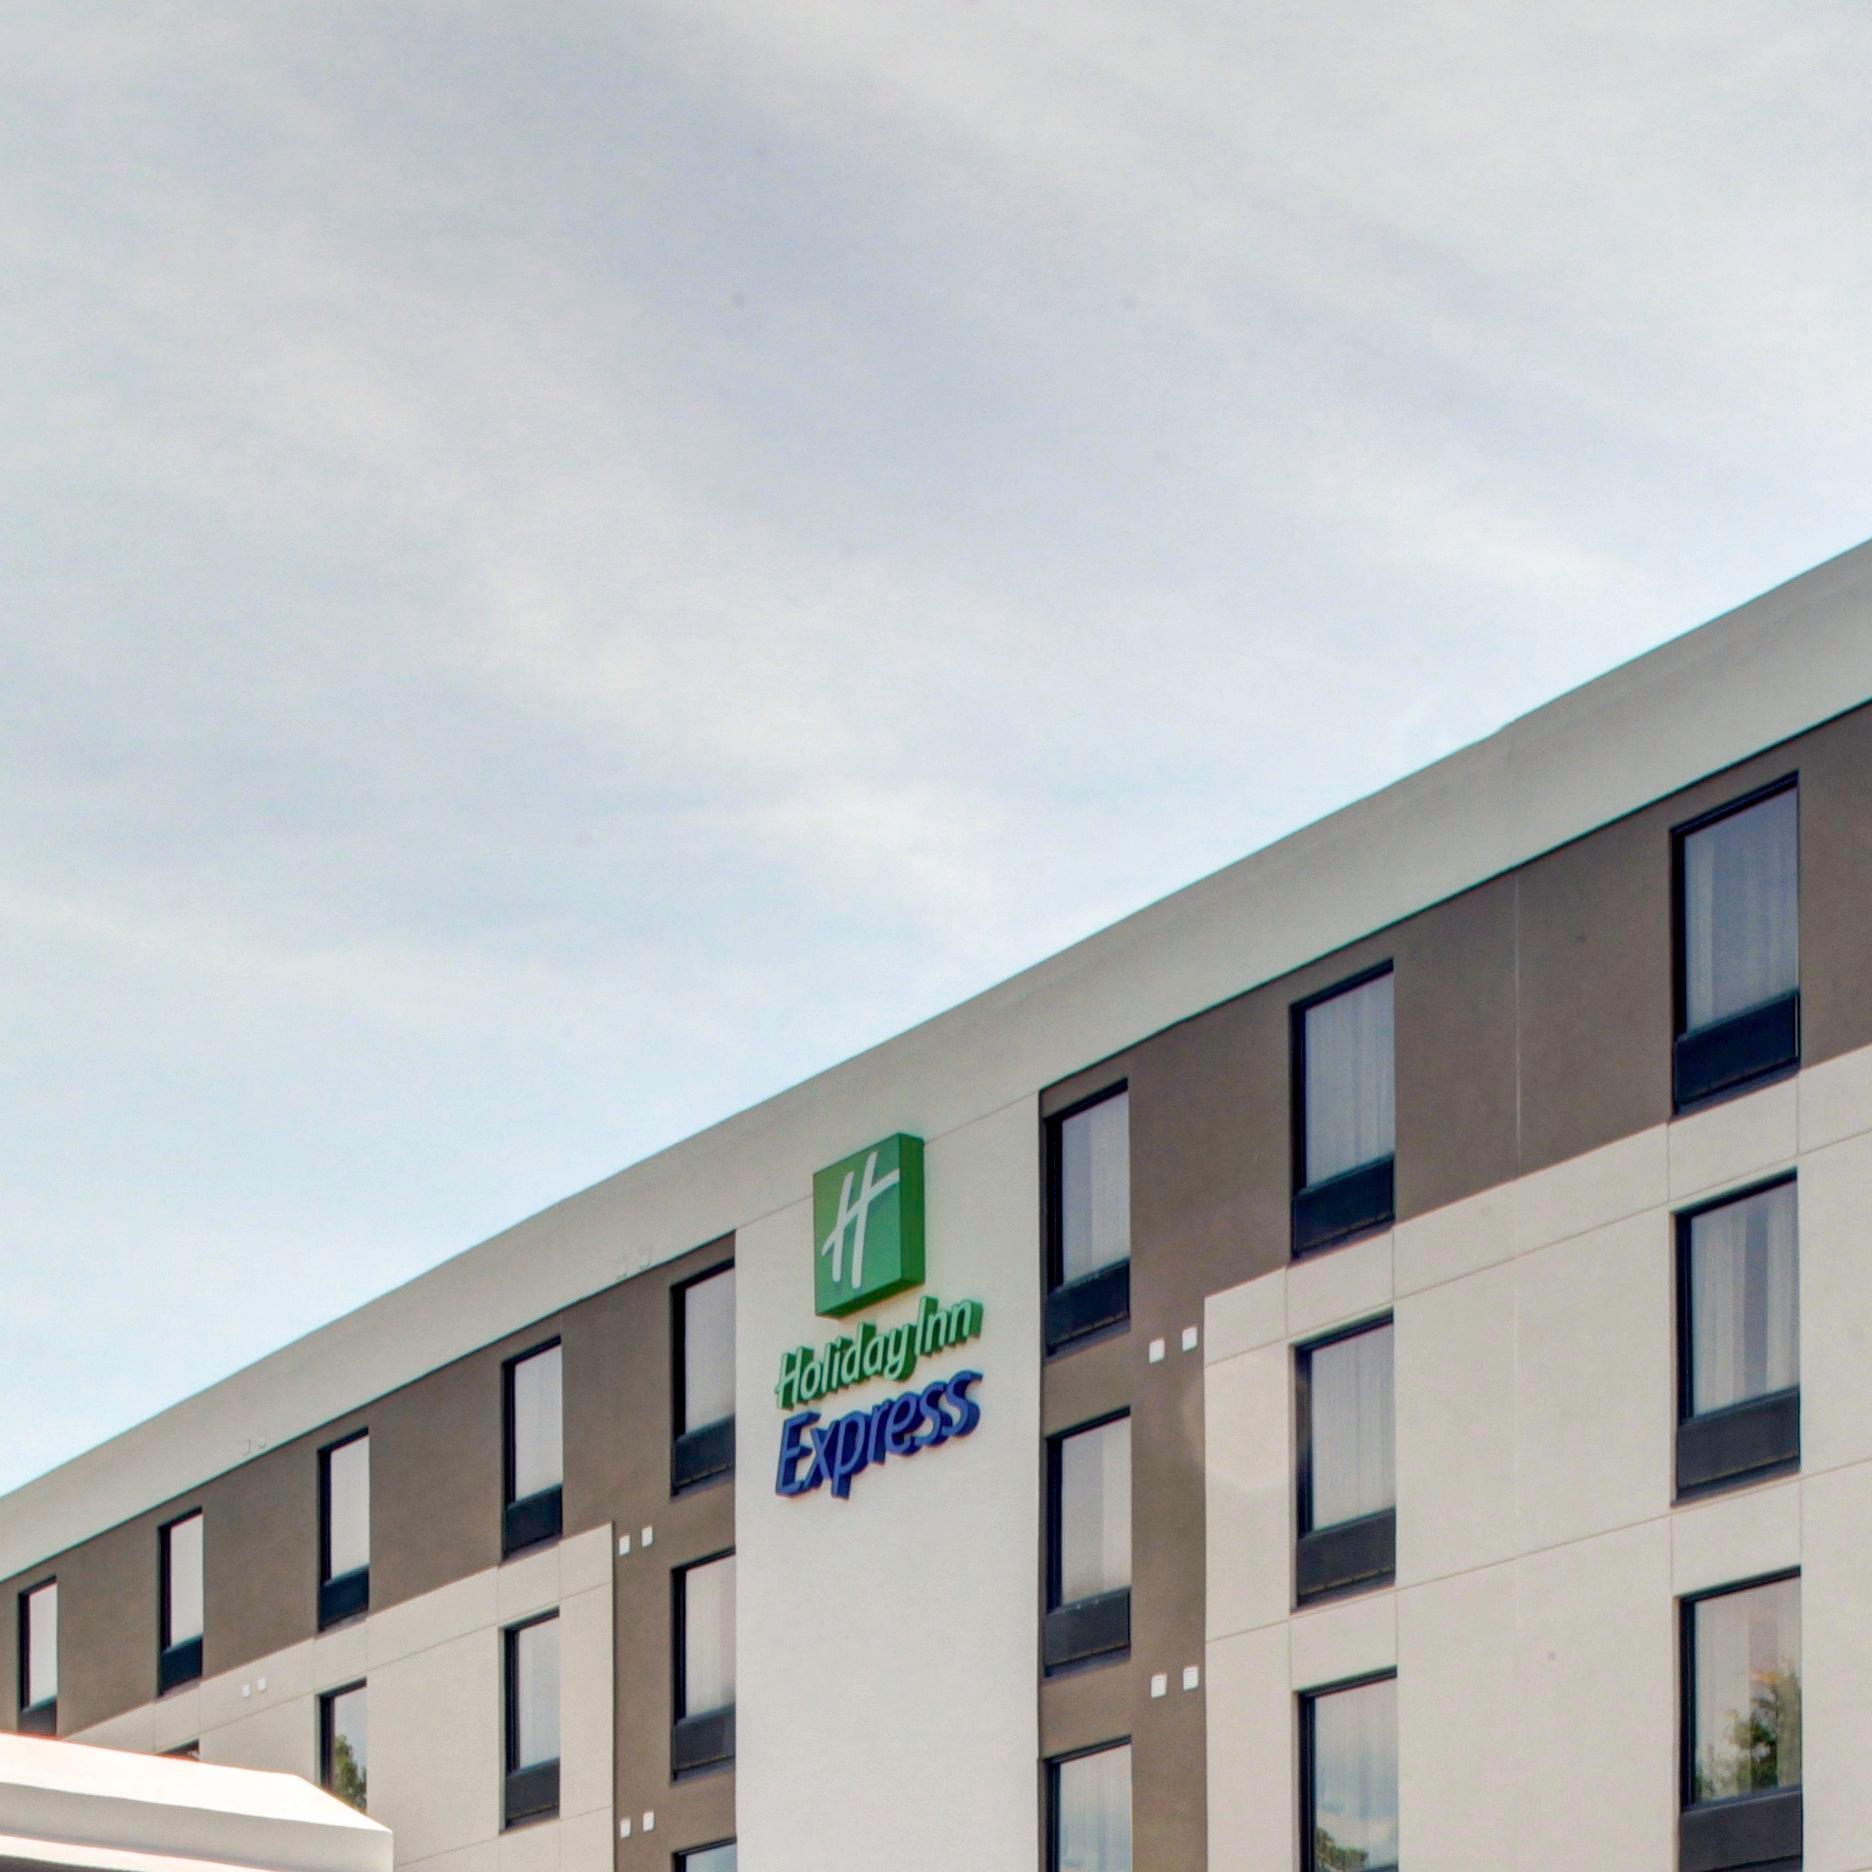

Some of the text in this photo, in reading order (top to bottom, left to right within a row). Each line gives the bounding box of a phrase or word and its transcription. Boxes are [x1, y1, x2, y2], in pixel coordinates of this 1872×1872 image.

[775, 1296, 984, 1410] Holiday Inn
[775, 1370, 984, 1500] Express
